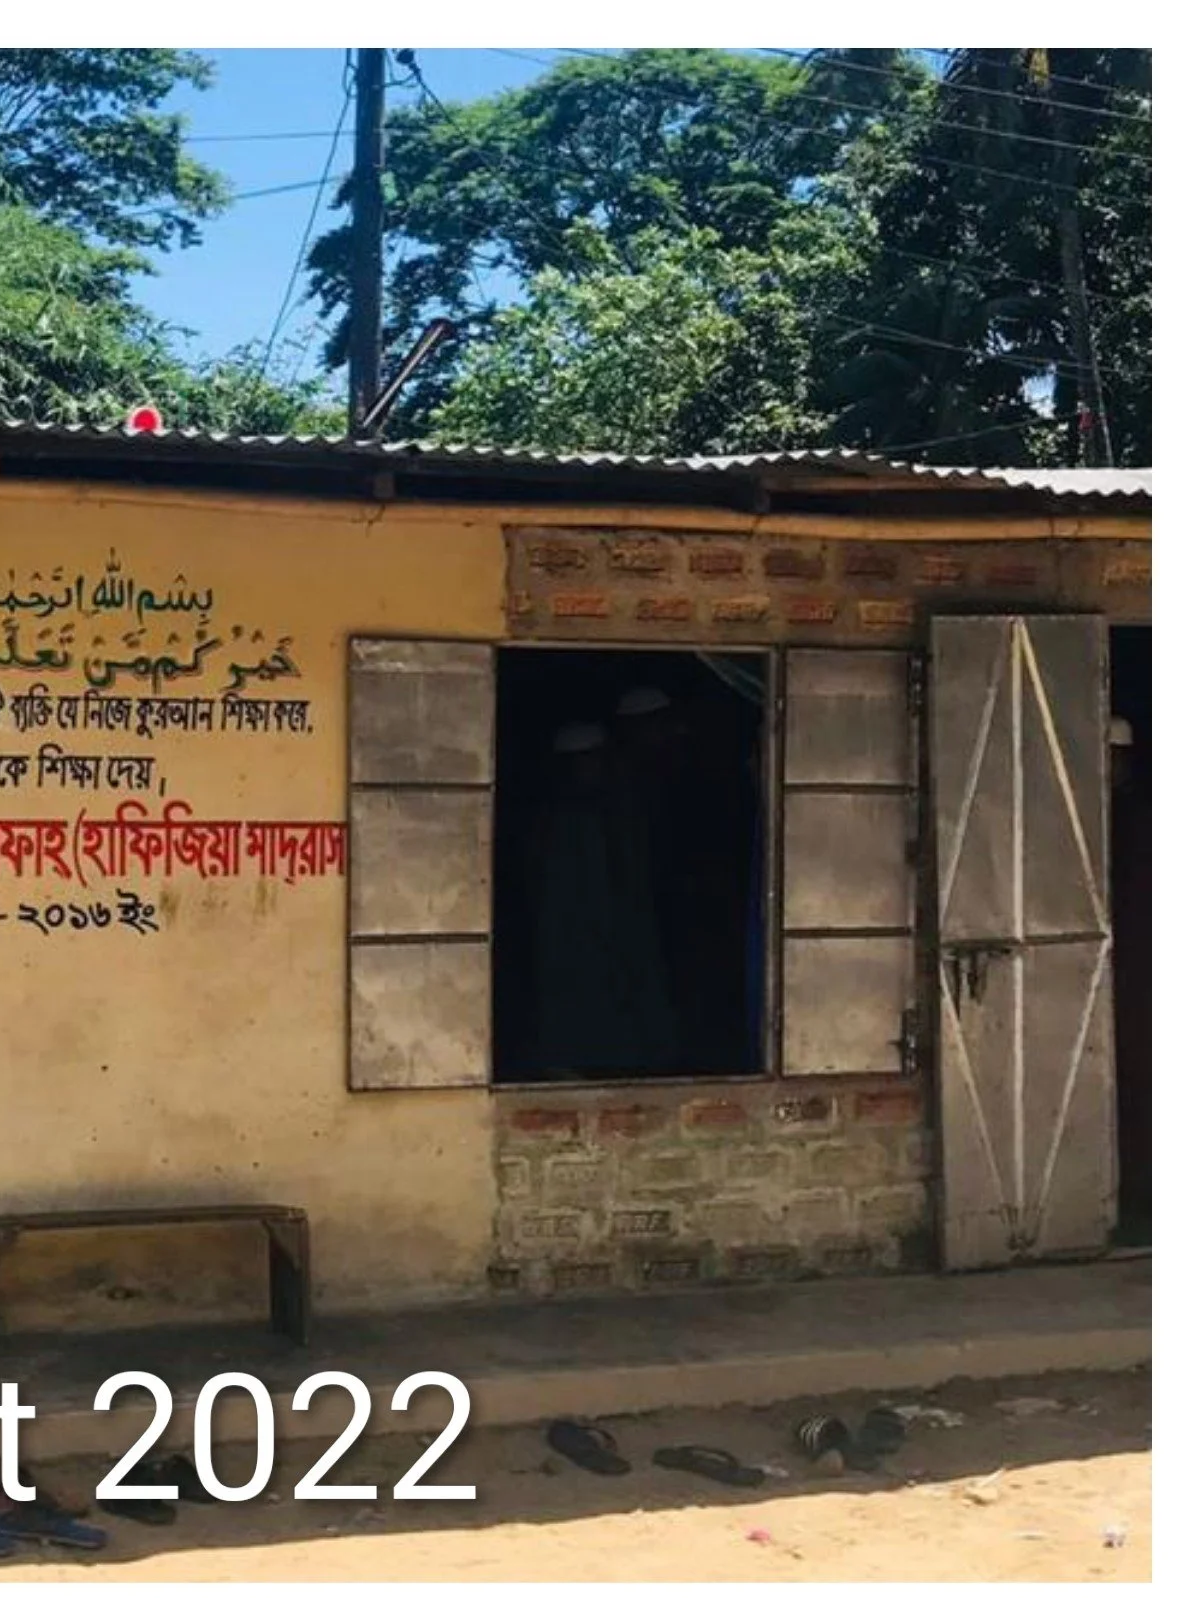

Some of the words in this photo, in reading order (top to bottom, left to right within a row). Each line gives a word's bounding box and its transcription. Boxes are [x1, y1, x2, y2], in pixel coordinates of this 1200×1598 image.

[57, 696, 79, 730] যে
[82, 688, 132, 731] নিজে
[134, 697, 215, 740] কুরআন
[220, 691, 272, 732] শিক্ষা
[36, 742, 102, 789] শিক্ষা
[17, 903, 111, 935] ২০১৬
[116, 888, 159, 935] ইং
